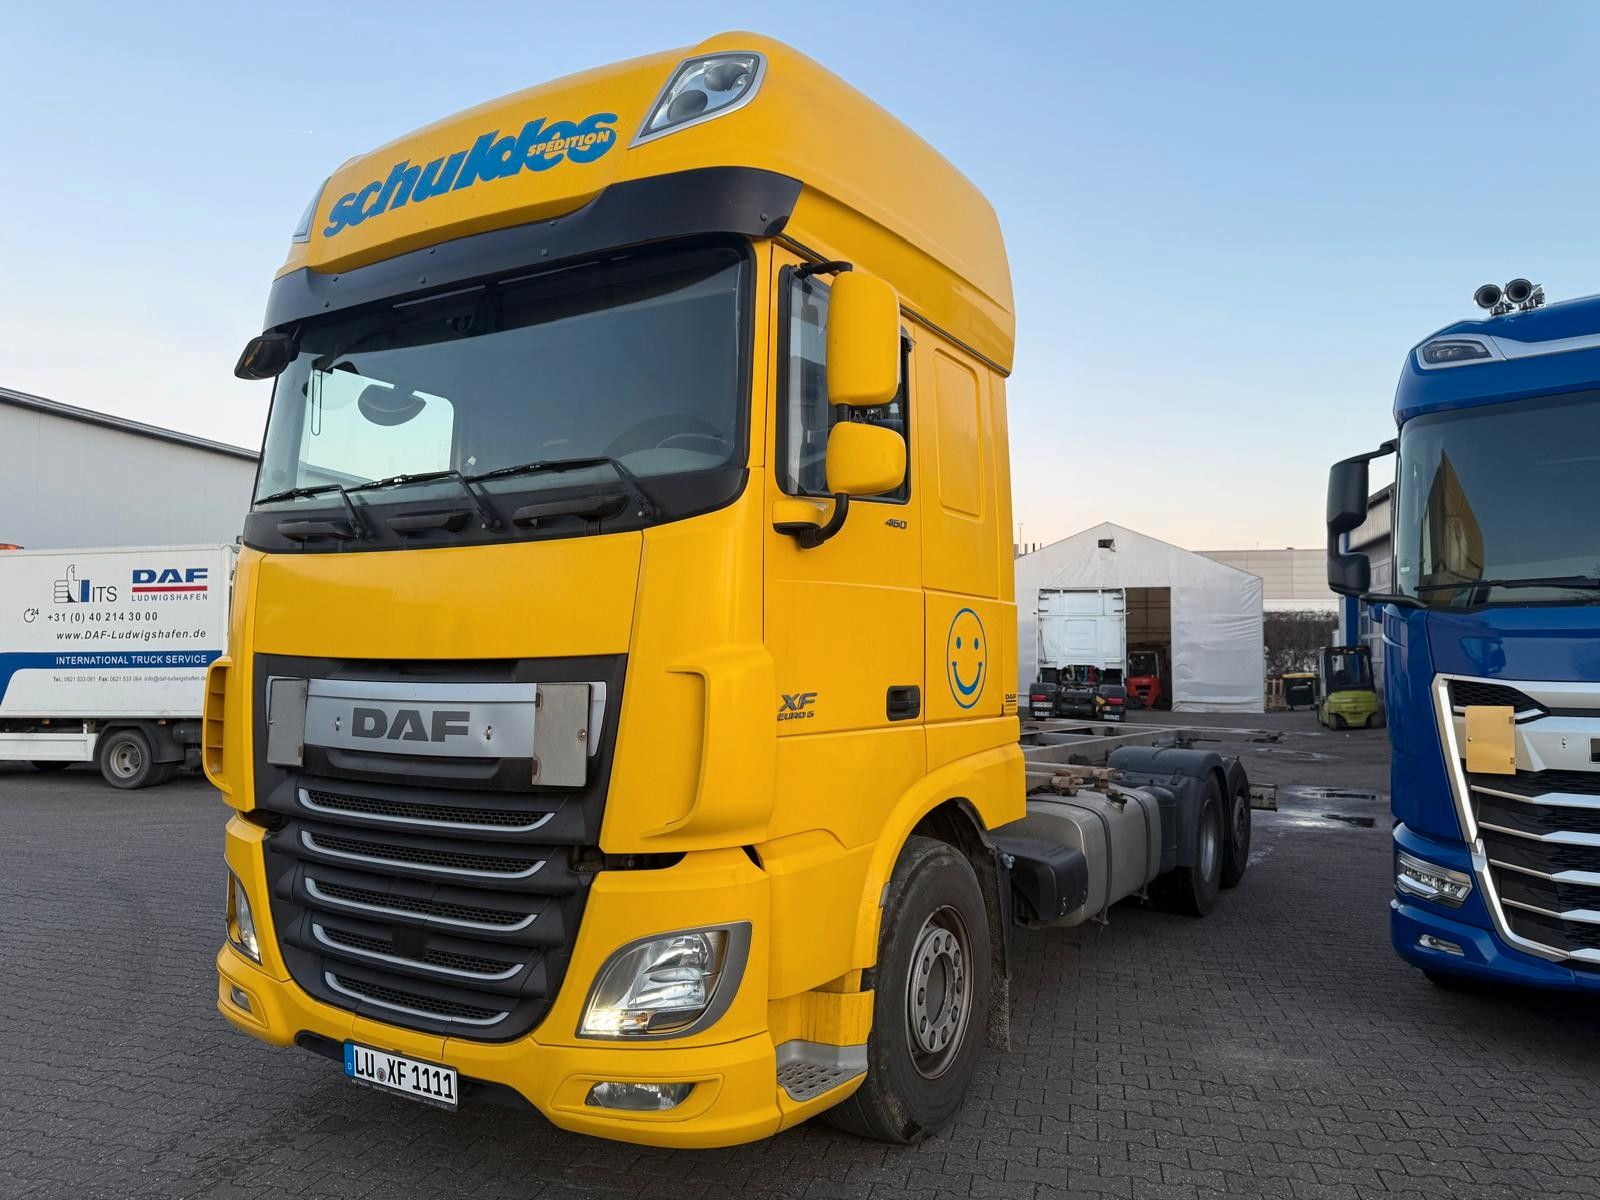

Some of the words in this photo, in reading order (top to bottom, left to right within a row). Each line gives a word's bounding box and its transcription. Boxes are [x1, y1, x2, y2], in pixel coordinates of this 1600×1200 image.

[526, 130, 611, 157] SPEDITION
[884, 518, 908, 530] 460
[132, 568, 208, 584] DAF
[91, 586, 118, 603] ITS
[131, 593, 208, 602] LUDWIGSHAFEN
[48, 612, 66, 622] +31
[70, 612, 85, 624] (0)
[89, 612, 101, 622] 40
[105, 611, 124, 622] 214
[128, 611, 141, 621] 30
[145, 611, 158, 621] 00
[56, 629, 206, 642] www.DAF-Ludwigshafen.de
[56, 656, 129, 665] INTERNATIONAL
[131, 656, 164, 664] TRUCK
[165, 654, 207, 664] SERVICE
[779, 692, 817, 711] XF
[777, 712, 806, 721] EURO
[351, 707, 471, 743] DAF
[355, 1049, 375, 1079] LU
[411, 1065, 454, 1099] 1111
